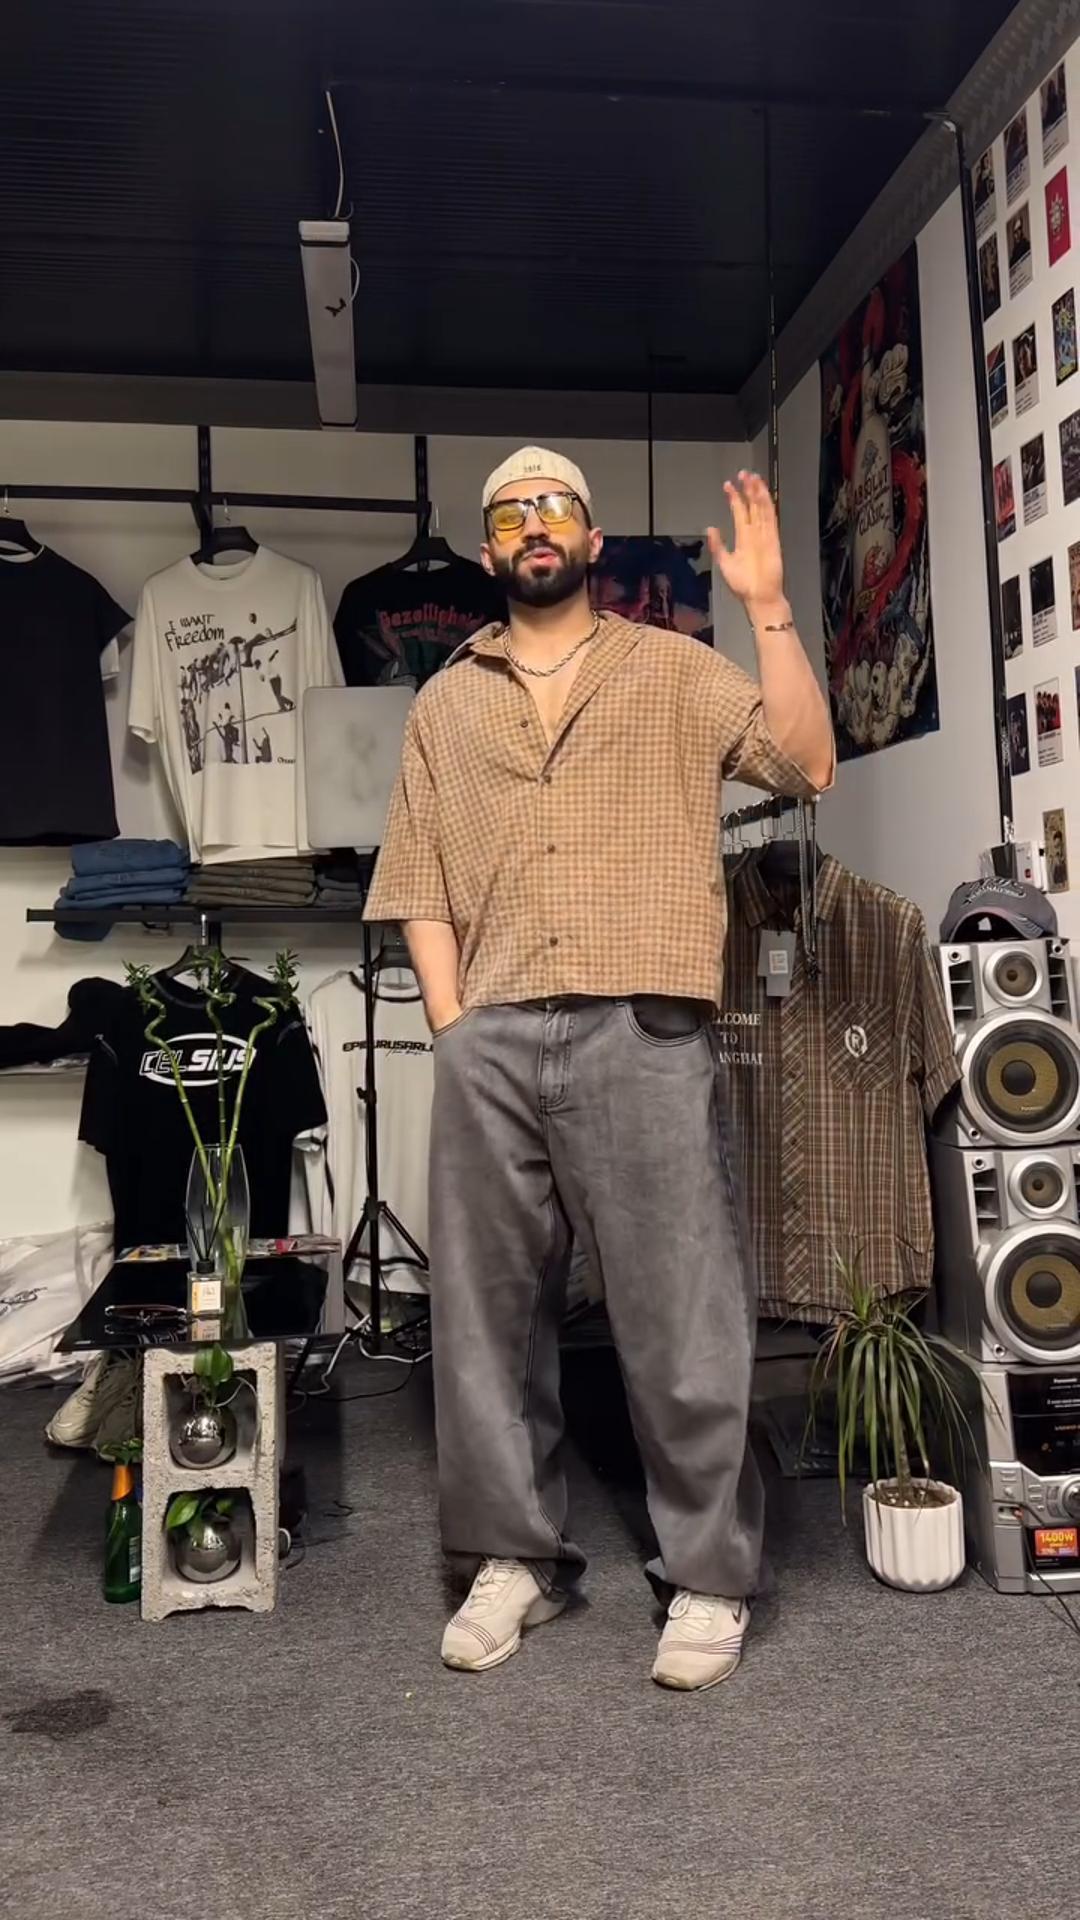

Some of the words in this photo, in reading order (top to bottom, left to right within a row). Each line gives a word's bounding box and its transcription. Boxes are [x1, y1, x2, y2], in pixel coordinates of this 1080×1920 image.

[180, 613, 215, 629] WANT
[720, 1031, 739, 1045] TO
[139, 1048, 257, 1076] CELSIUS
